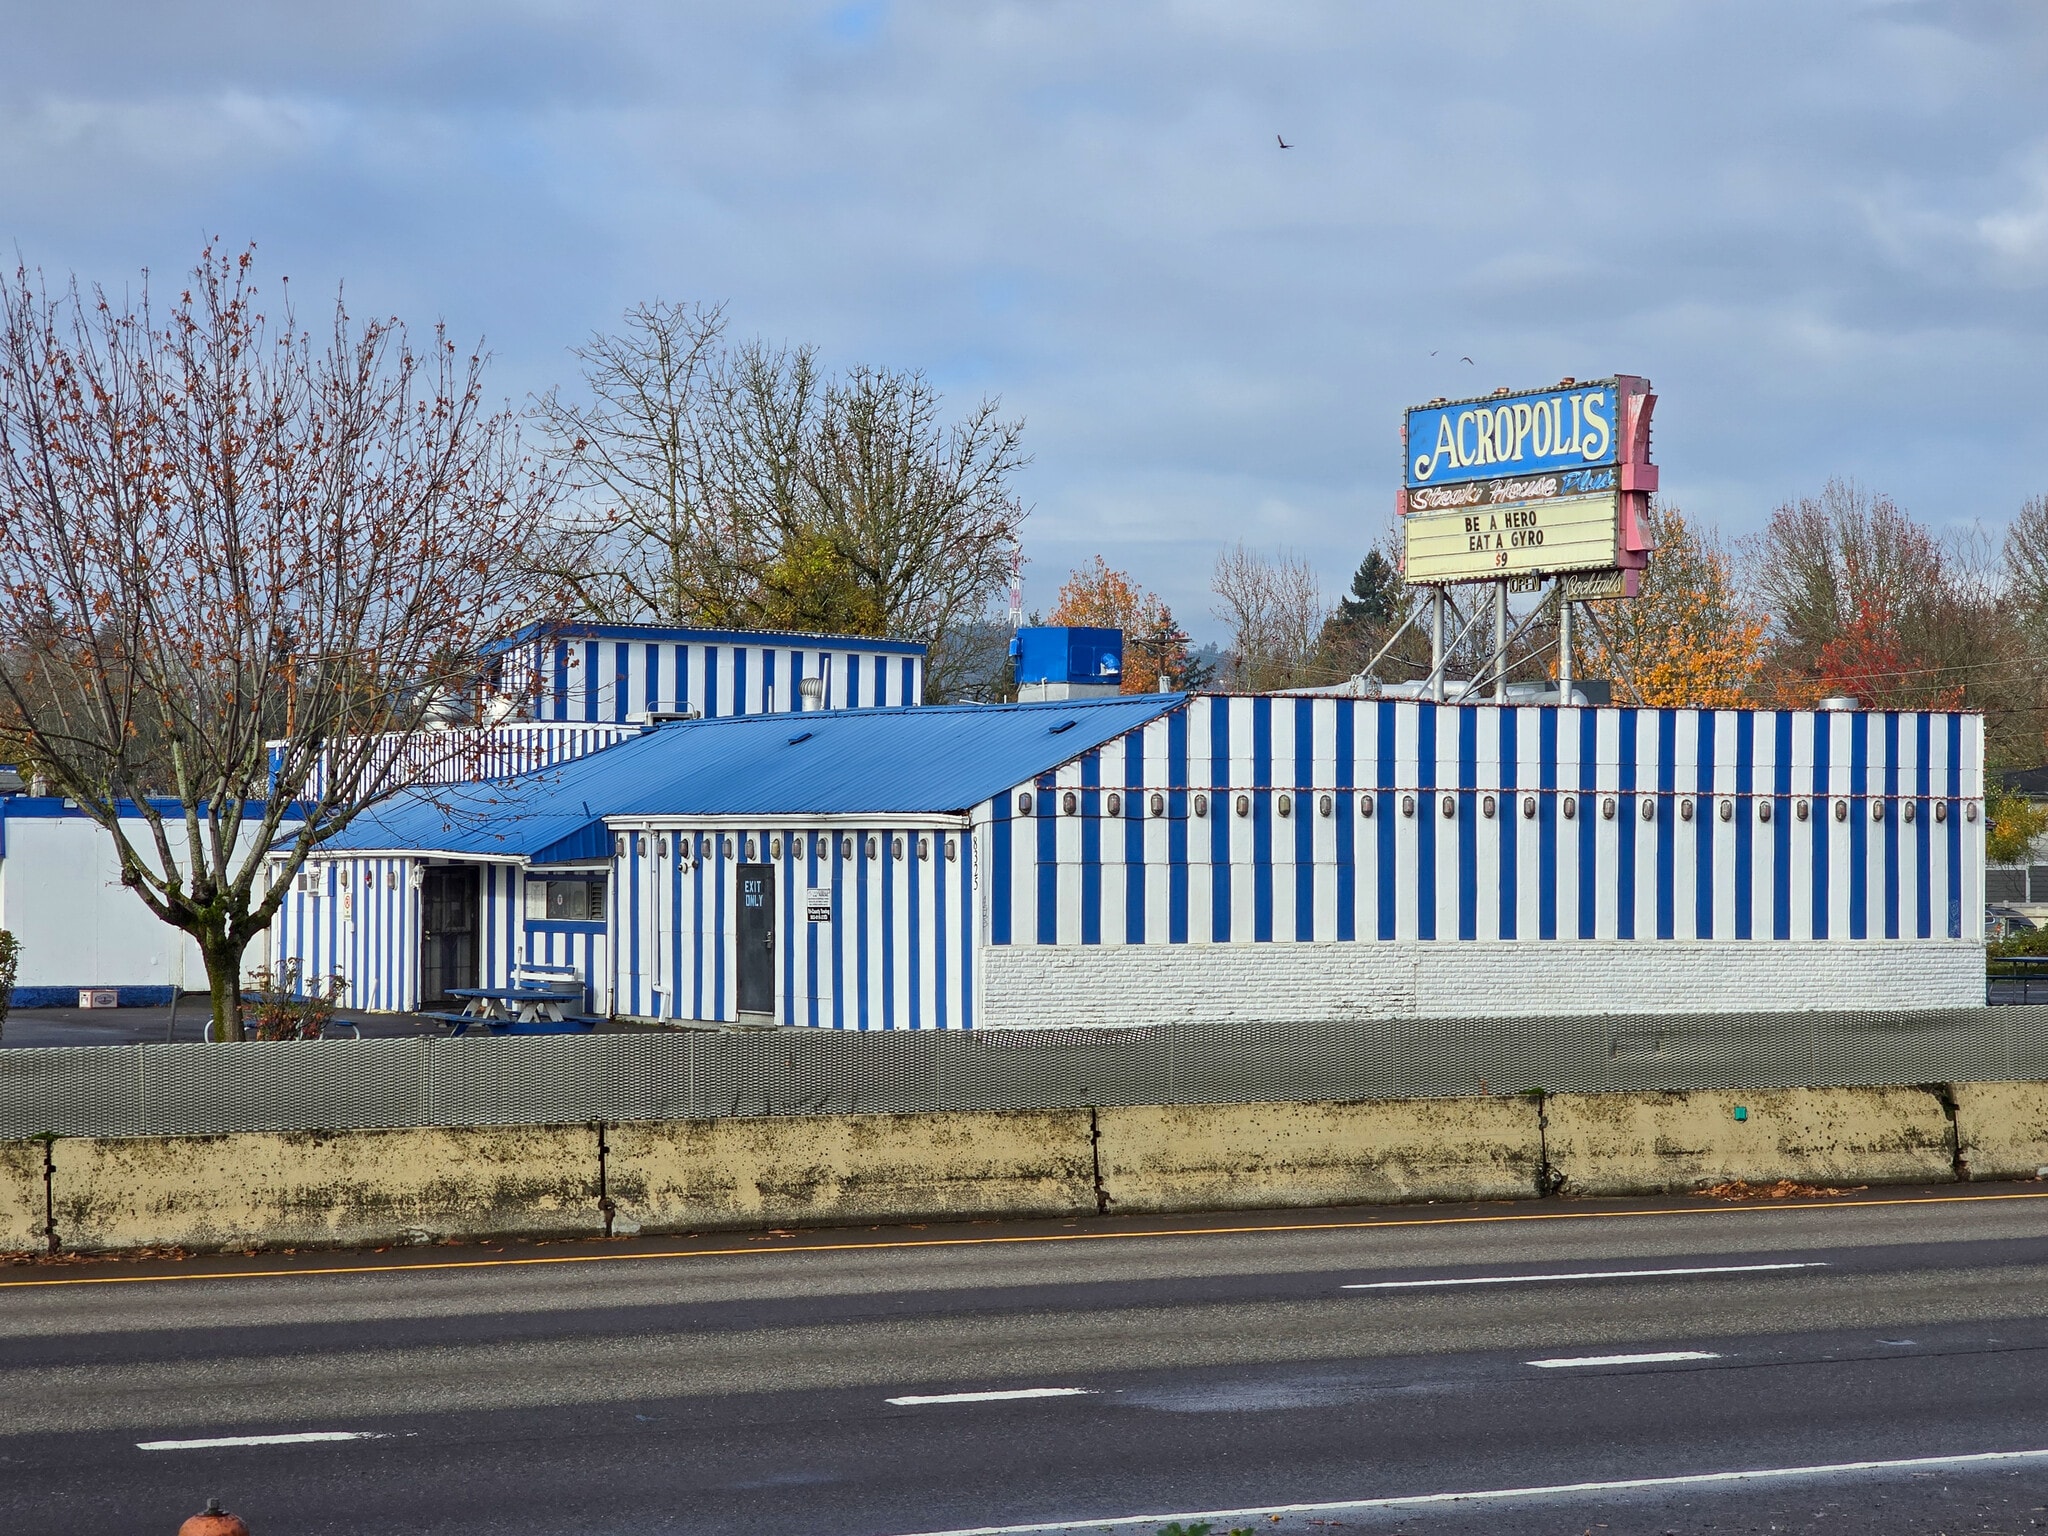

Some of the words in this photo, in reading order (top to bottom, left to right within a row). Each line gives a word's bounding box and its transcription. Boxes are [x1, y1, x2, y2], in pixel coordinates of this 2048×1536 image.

[1414, 392, 1610, 481] ACROPOLIS
[1488, 476, 1557, 504] House
[1561, 469, 1615, 495] Plus
[1464, 516, 1480, 532] BE
[1489, 514, 1498, 531] A
[1504, 510, 1537, 528] HERO
[1469, 534, 1491, 551] EAT
[1495, 533, 1504, 549] A
[1511, 529, 1544, 547] GYRO
[1495, 552, 1508, 567] $9
[1510, 577, 1540, 592] OPEN
[1566, 571, 1621, 597] Cocktails
[744, 880, 762, 893] EXIT
[745, 894, 764, 907] ONLY
